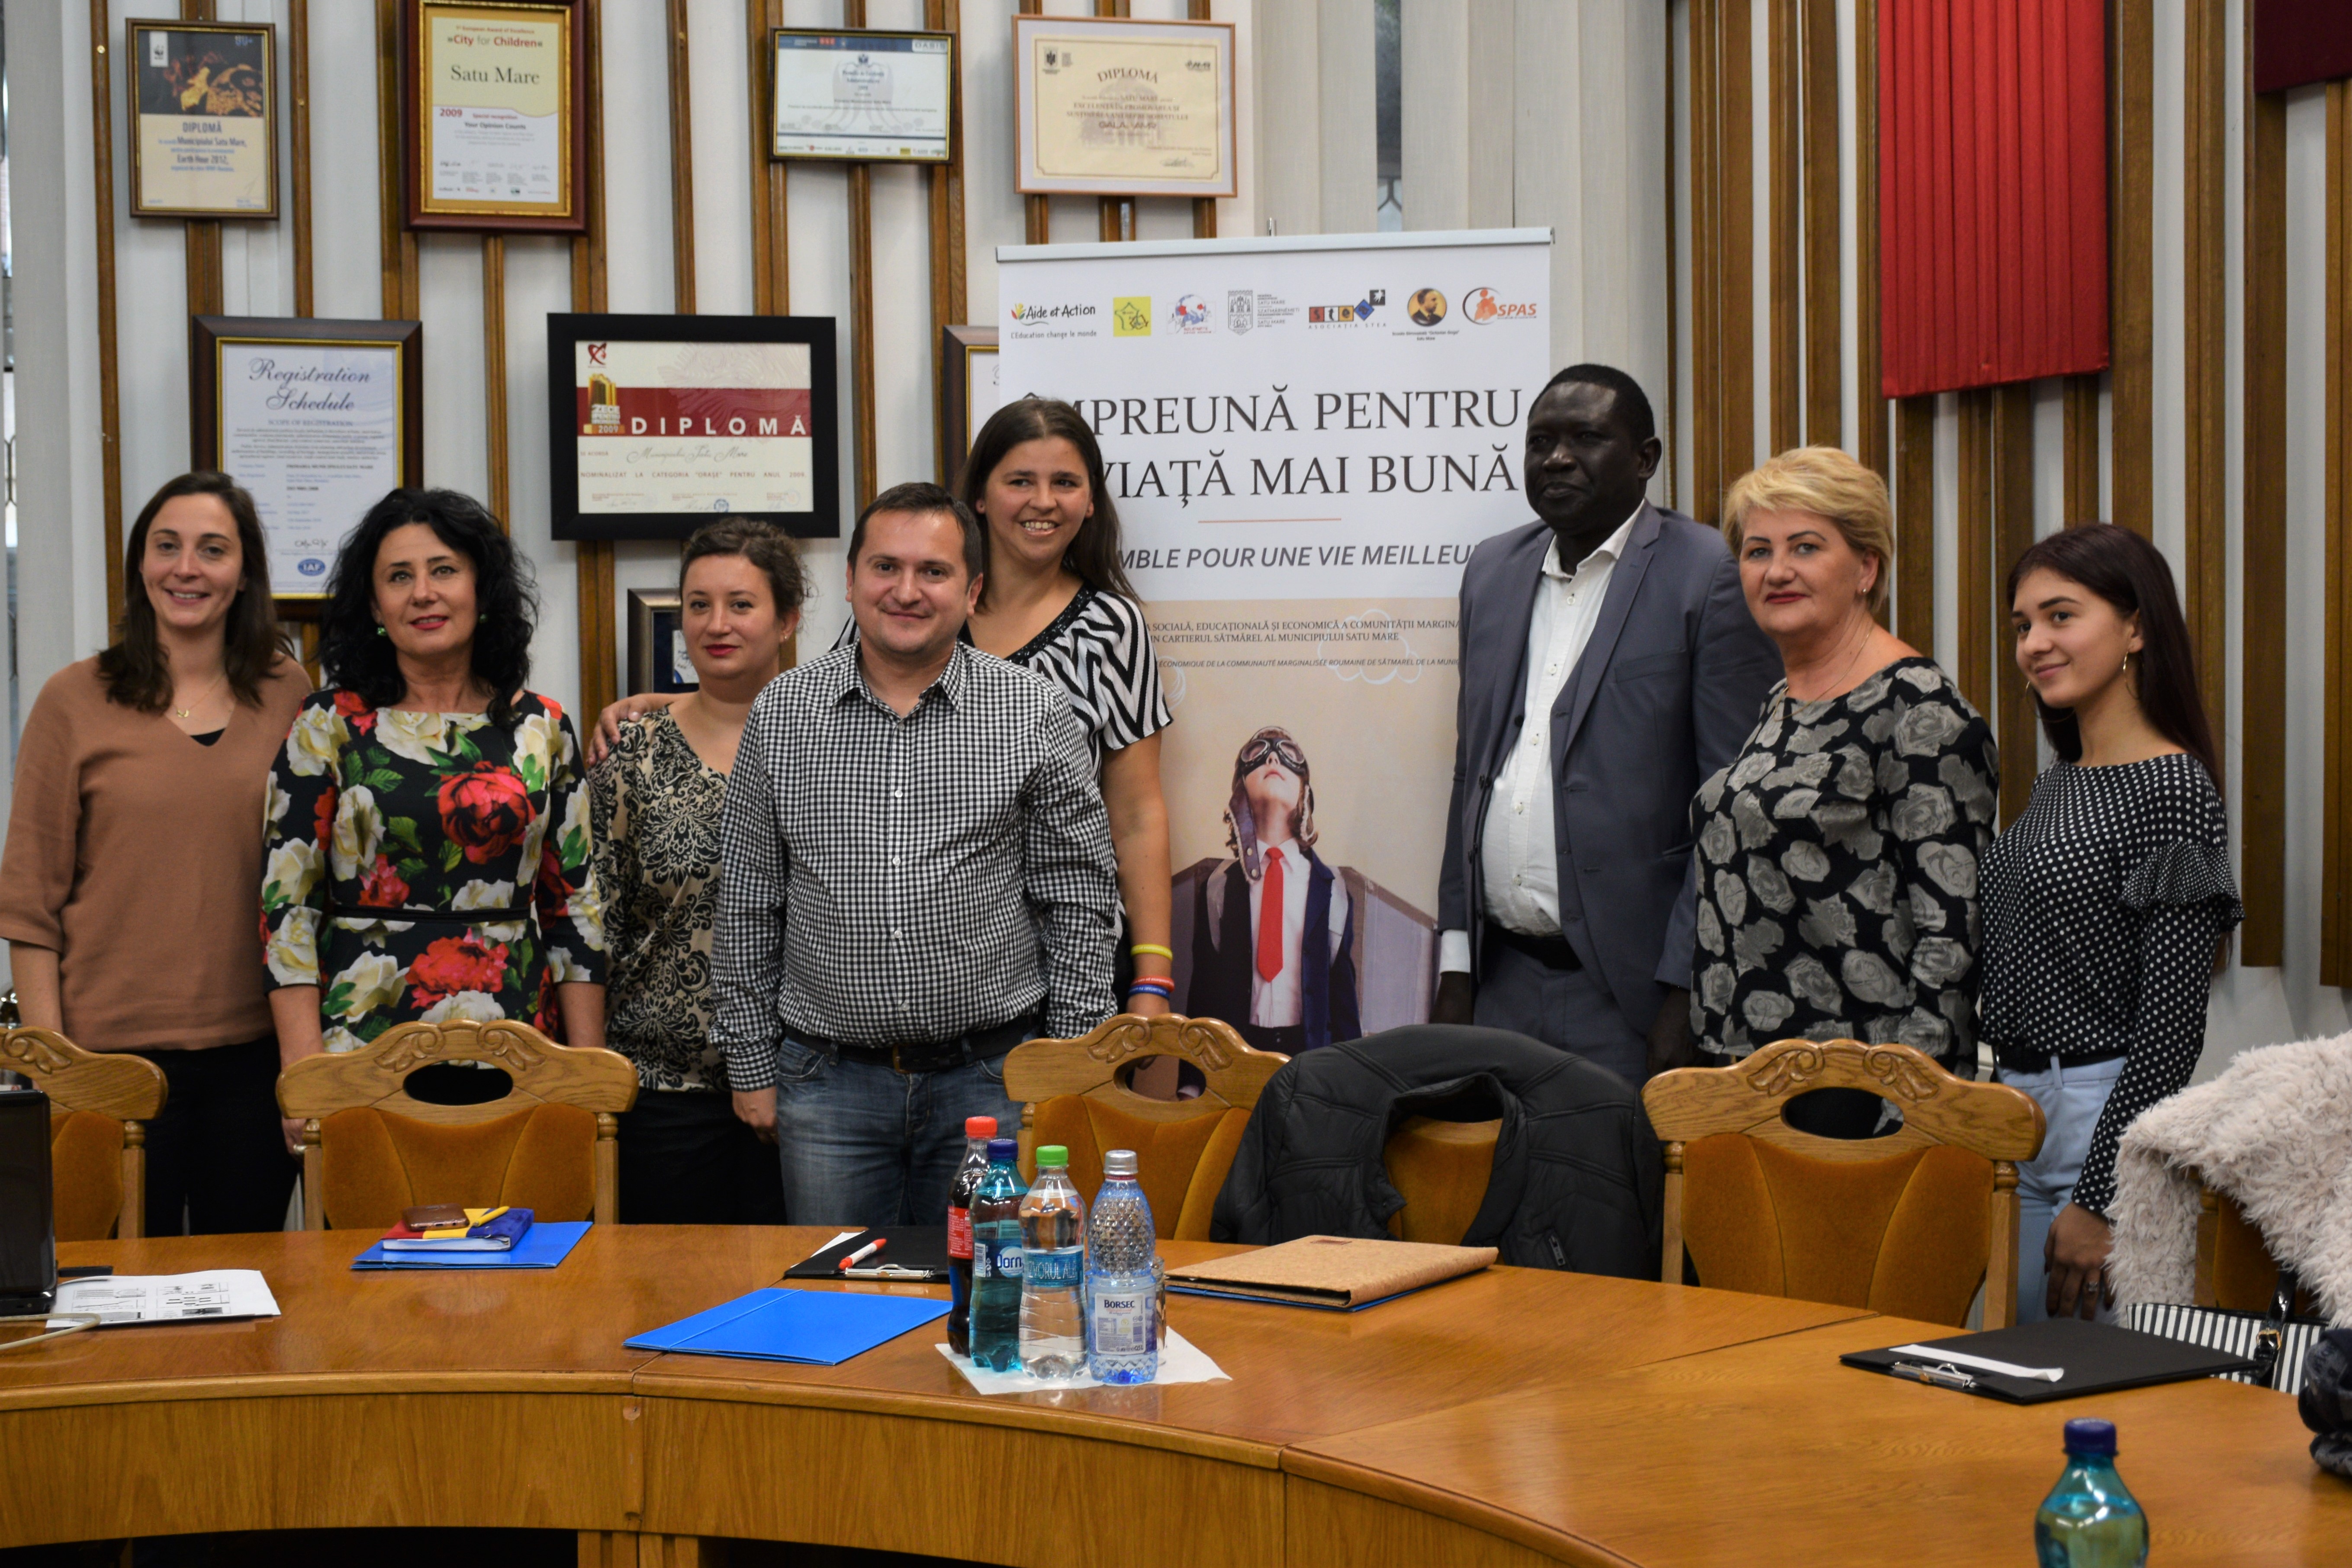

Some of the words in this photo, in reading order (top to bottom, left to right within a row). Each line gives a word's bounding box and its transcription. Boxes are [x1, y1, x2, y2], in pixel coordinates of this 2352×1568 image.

[477, 36, 490, 45] for
[450, 65, 488, 81] Satu
[495, 67, 540, 84] Mare
[440, 108, 463, 117] 2009
[183, 121, 222, 133] DIPLOMĂ
[1026, 306, 1048, 319] Aide
[1050, 306, 1060, 317] et
[1062, 303, 1095, 318] Action
[1497, 303, 1537, 317] SPAS
[1047, 331, 1067, 339] change
[248, 357, 370, 390] Registration
[266, 387, 354, 410] Schedule
[1314, 389, 1522, 430] PENTRU
[598, 425, 618, 433] 2009
[631, 415, 806, 435] DIPLOMĂ
[1250, 457, 1349, 496] MAI
[1368, 444, 1519, 493] BUNĂ
[1186, 548, 1255, 568] POUR
[1261, 547, 1313, 567] UNE
[1319, 546, 1356, 566] VIE
[1152, 621, 1194, 632] SOCIALĂ,
[1282, 620, 1341, 630] ECONOMICĂ
[1162, 634, 1213, 643] CARTIERUL
[1214, 633, 1262, 642] SĂTMĂREL
[1278, 633, 1344, 641] MUNICIPIULUI
[1346, 633, 1369, 641] SATU
[1372, 633, 1399, 641] MARE
[1104, 1300, 1135, 1308] BORSEC
